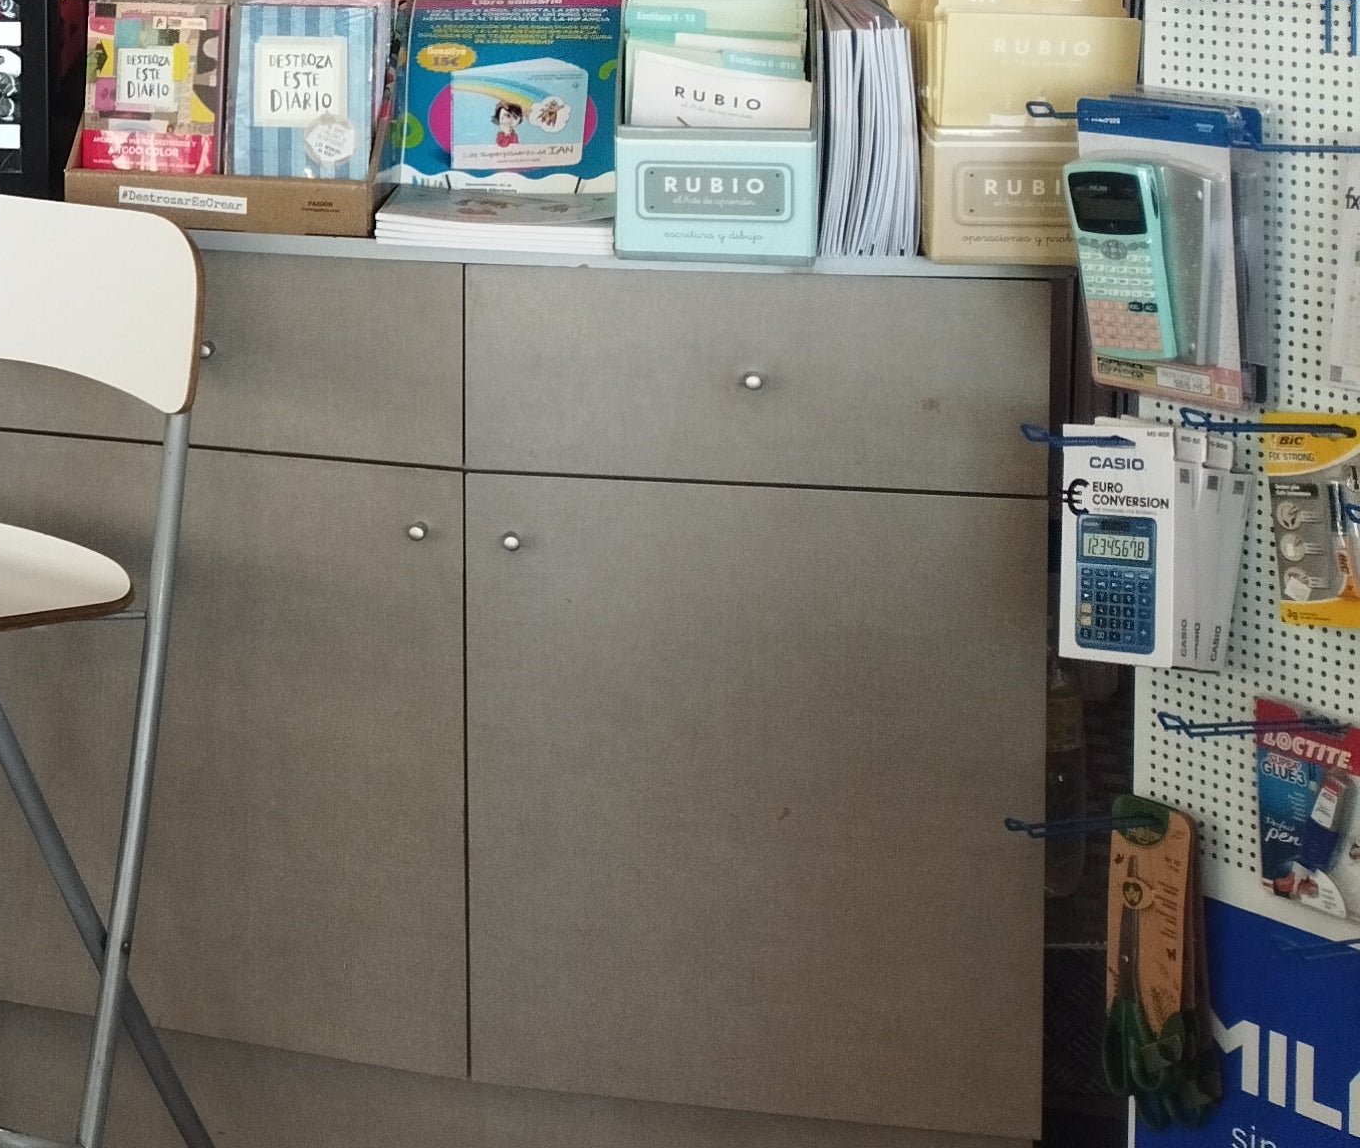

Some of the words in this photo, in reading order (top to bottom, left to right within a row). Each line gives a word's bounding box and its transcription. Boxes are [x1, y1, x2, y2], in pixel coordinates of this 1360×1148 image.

[994, 39, 1091, 56] RUBIO
[126, 54, 170, 66] DESTROZA
[270, 53, 332, 68] DESTROZA
[136, 68, 160, 80] ESTE
[284, 72, 319, 88] ESTE
[127, 82, 169, 99] DIARIO
[674, 85, 762, 111] RUBIO
[270, 89, 332, 112] DIARIO
[548, 146, 574, 155] IAN
[663, 176, 765, 194] RUBIO
[984, 179, 1060, 195] RUBI
[121, 190, 243, 211] #DestrozarEsCrear
[663, 229, 715, 241] escritura
[717, 232, 726, 244] y
[728, 228, 765, 244] dibujo
[1089, 457, 1144, 470] CASIO
[1268, 452, 1281, 461] FIX
[1283, 452, 1314, 462] STRONG
[1092, 482, 1123, 493] EURO
[1092, 495, 1170, 508] CONVERSION
[1087, 537, 1144, 557] 12345678
[1210, 625, 1222, 661] CASIO
[1263, 732, 1351, 769] LOCTITE
[1265, 828, 1303, 846] pen
[1210, 1008, 1360, 1138] MIL
